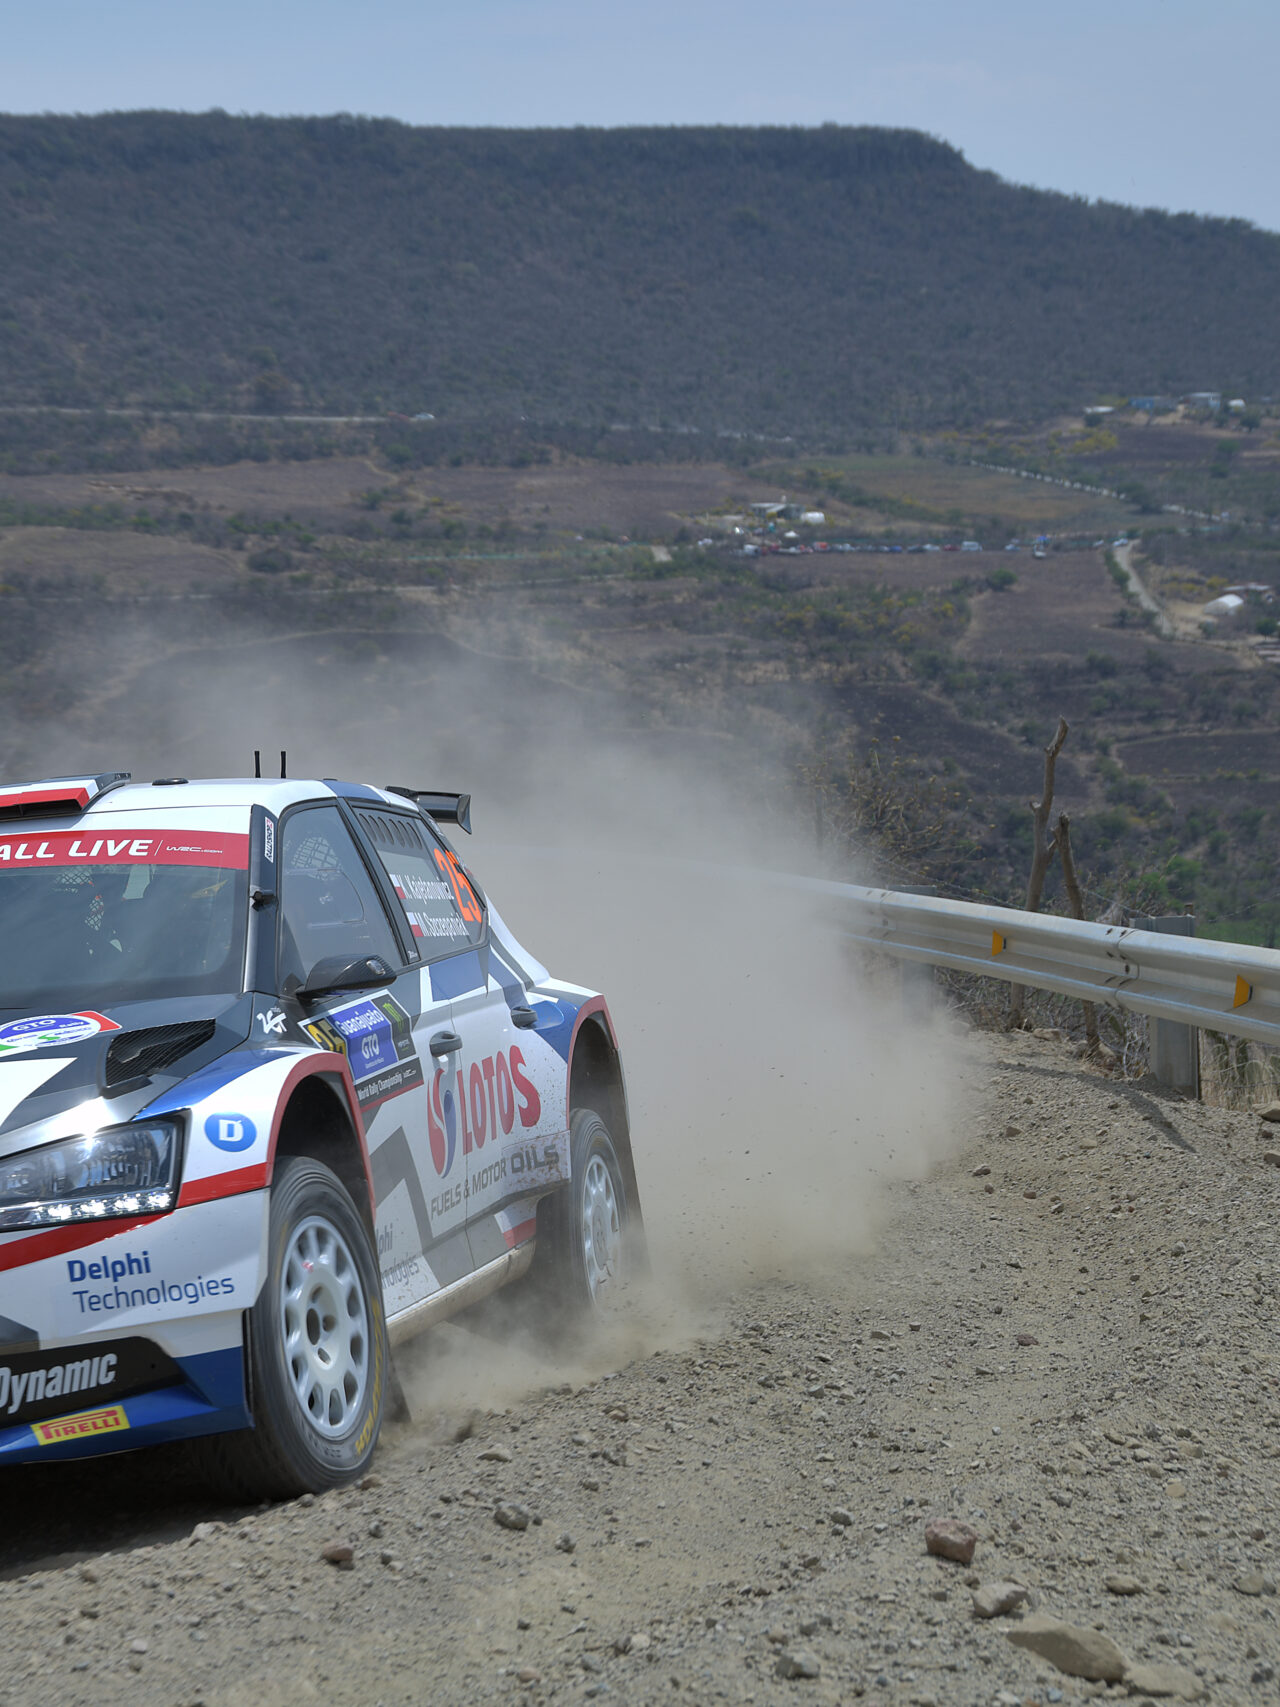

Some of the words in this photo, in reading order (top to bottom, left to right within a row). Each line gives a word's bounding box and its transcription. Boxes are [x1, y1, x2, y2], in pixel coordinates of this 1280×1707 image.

[68, 839, 154, 857] LIVE
[434, 848, 482, 923] 25
[12, 1018, 56, 1031] GTO
[362, 1033, 380, 1060] GTO
[456, 1045, 541, 1156] LOTOS
[430, 1183, 462, 1221] FUELS
[473, 1158, 507, 1196] MOTOR
[511, 1144, 560, 1175] OILS
[67, 1250, 151, 1282] Delphi
[73, 1275, 235, 1313] Technologies
[39, 1408, 121, 1440] PIRELLI
